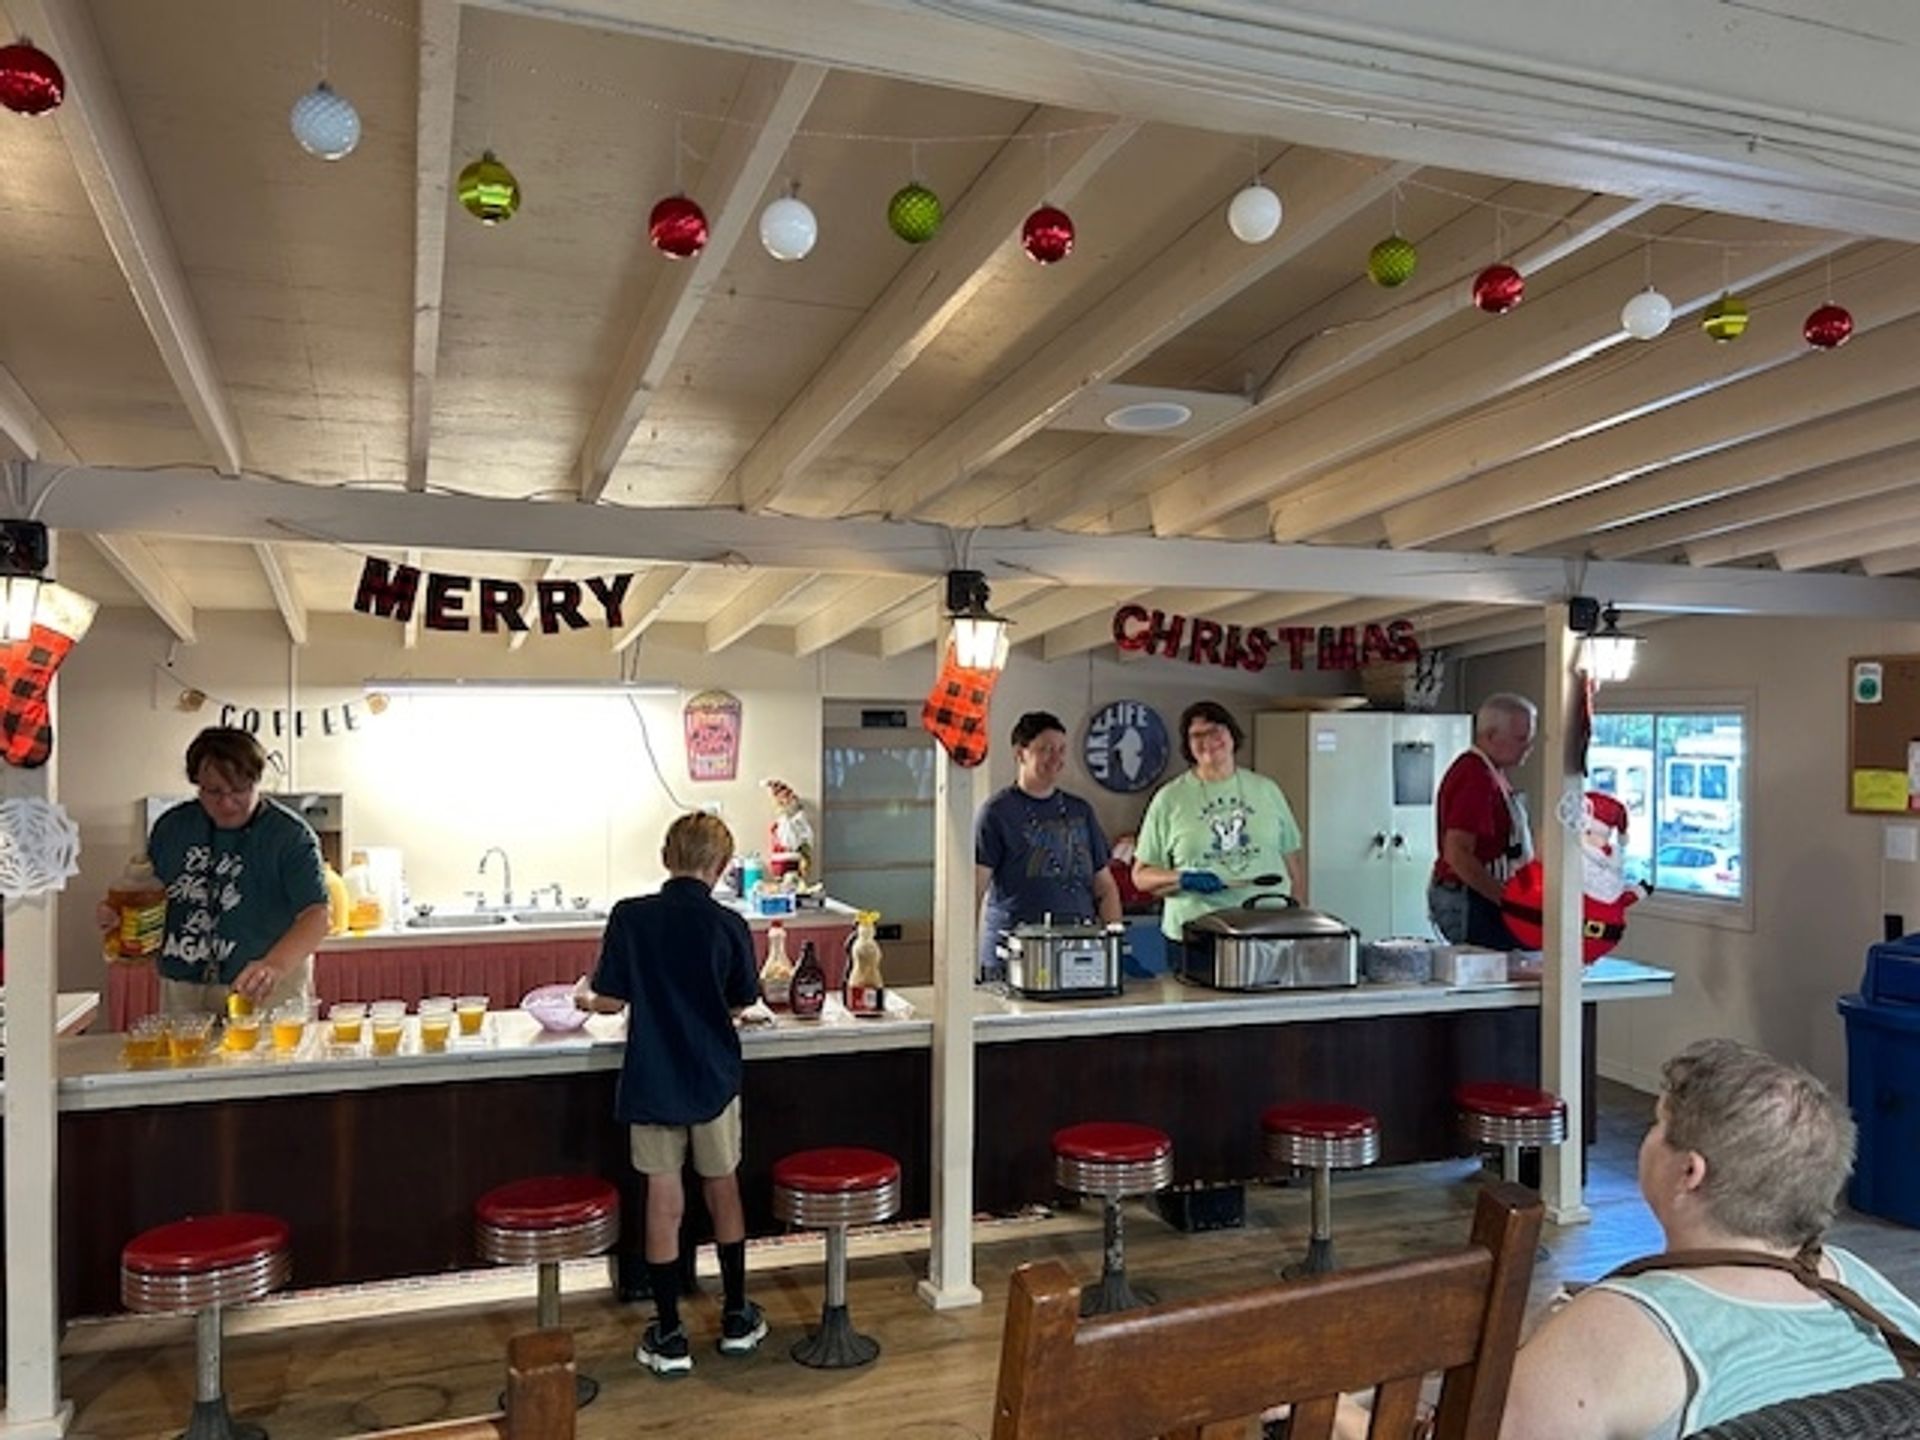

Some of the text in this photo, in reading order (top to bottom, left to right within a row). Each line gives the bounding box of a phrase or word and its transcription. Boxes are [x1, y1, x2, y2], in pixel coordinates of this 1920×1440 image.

[354, 556, 634, 634] MERRY
[1112, 604, 1420, 673] CHRISTMAS
[221, 704, 360, 738] COFFEE
[1107, 703, 1147, 728] LIFE
